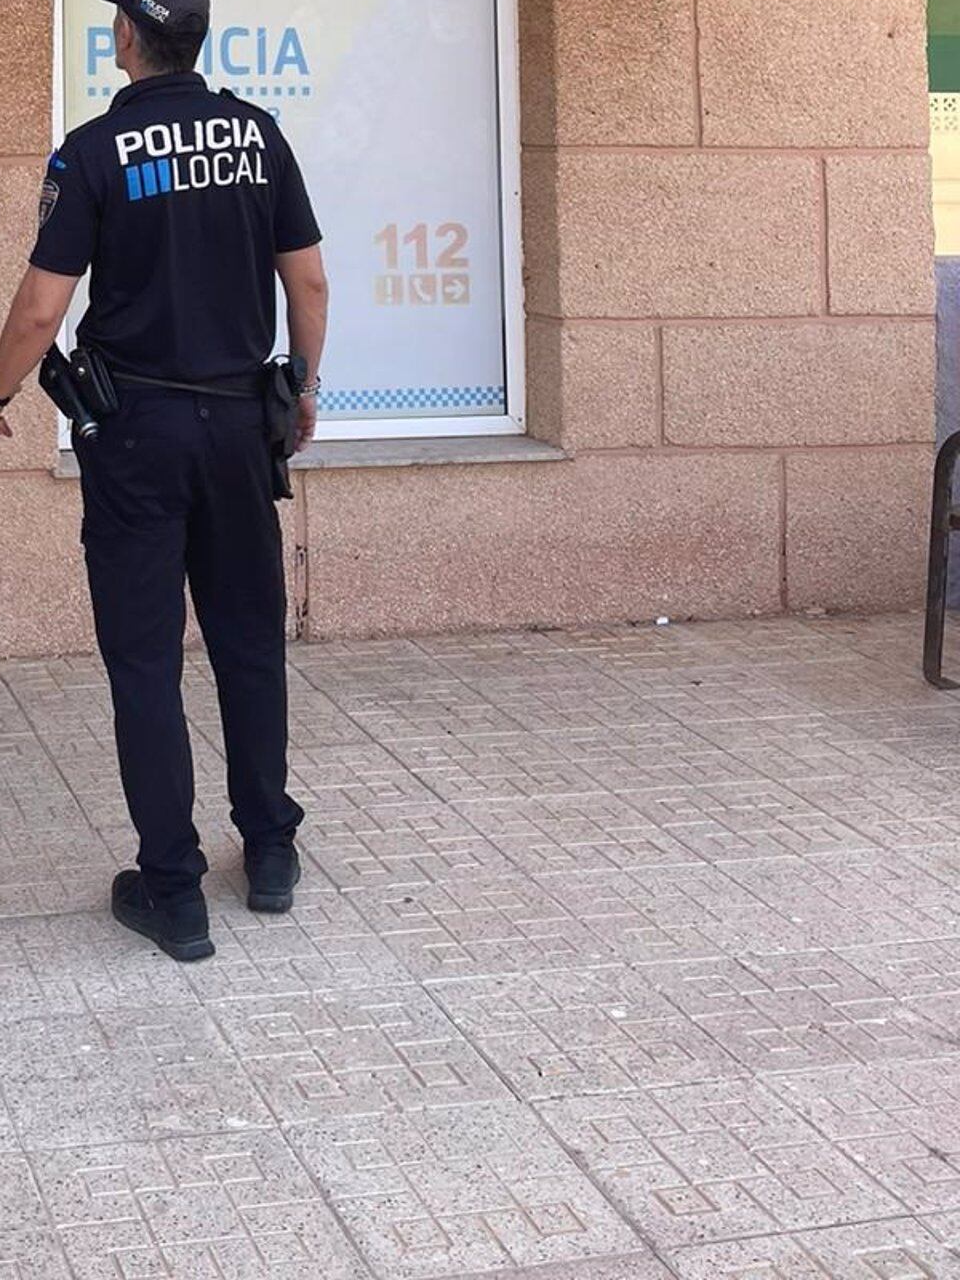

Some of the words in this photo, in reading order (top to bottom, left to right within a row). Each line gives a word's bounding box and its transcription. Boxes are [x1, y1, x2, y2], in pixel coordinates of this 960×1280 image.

[87, 26, 310, 76] PICIA
[115, 117, 266, 166] POLICIA
[172, 151, 269, 191] LOCAL
[373, 222, 470, 270] 112
